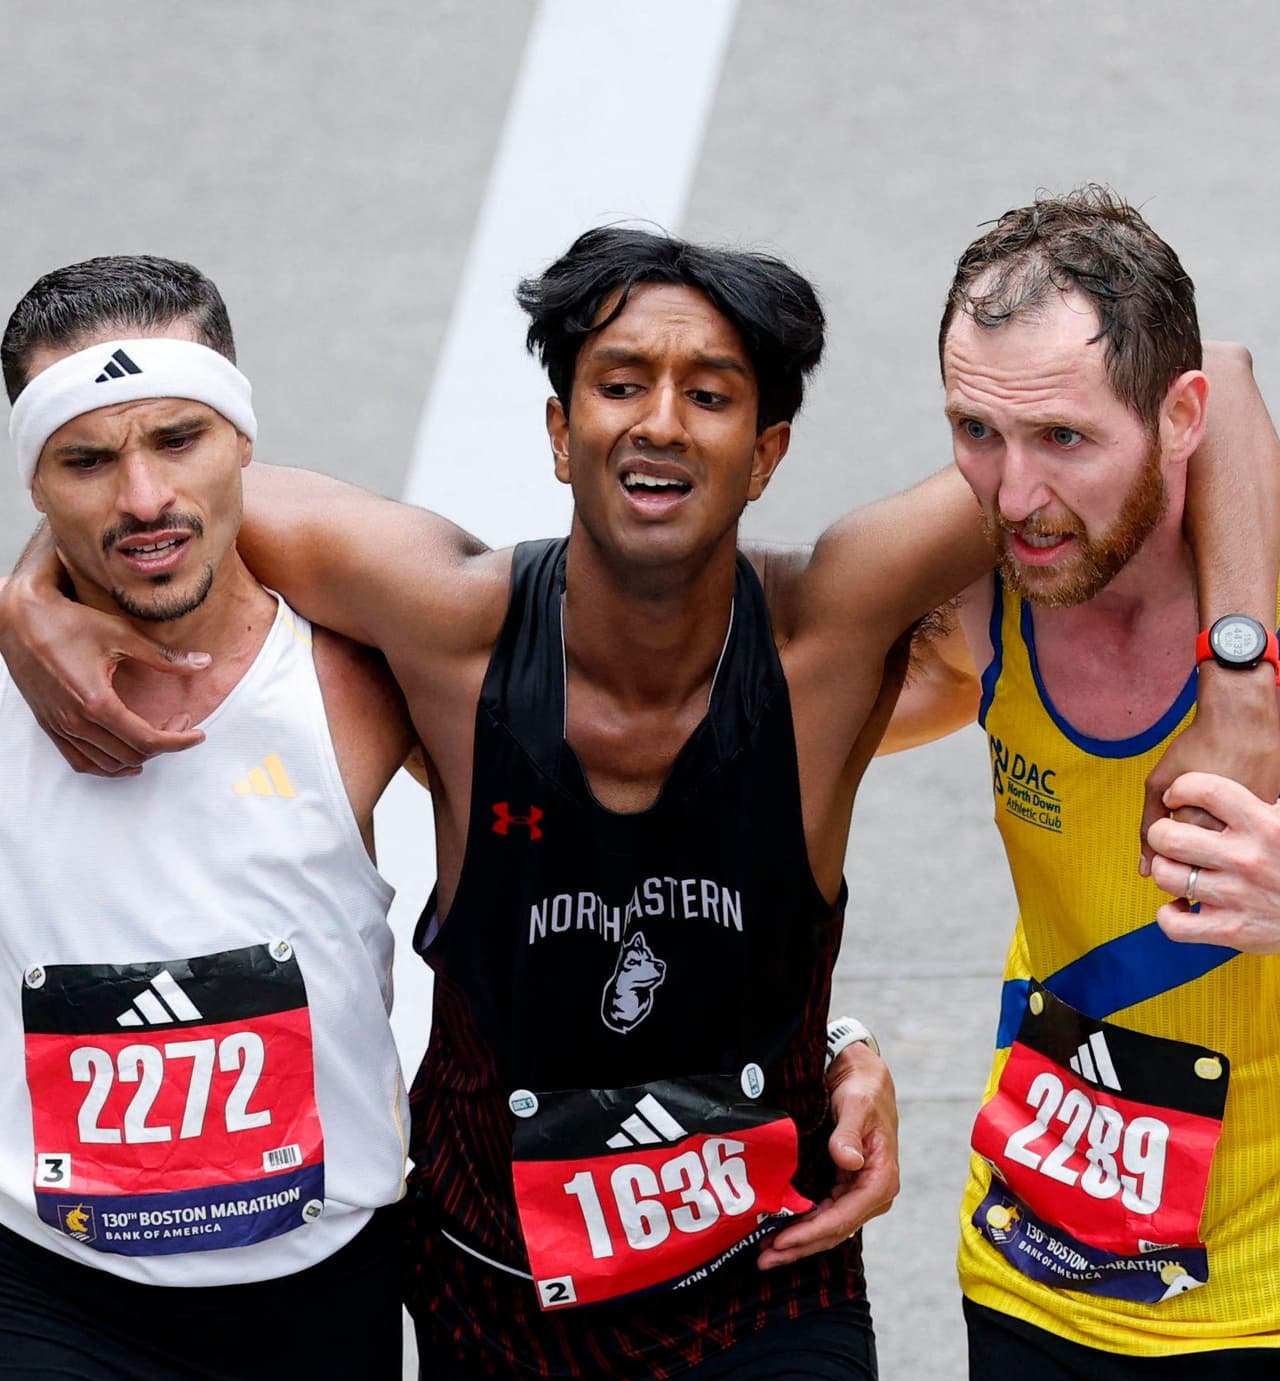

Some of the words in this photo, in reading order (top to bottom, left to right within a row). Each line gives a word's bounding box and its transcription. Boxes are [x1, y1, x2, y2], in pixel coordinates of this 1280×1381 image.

[1006, 797, 1037, 821] Athletic
[1039, 812, 1062, 828] Club
[1007, 780, 1030, 803] North
[1032, 795, 1061, 813] Down
[529, 876, 743, 945] NORHASTERN
[69, 1032, 271, 1145] 2272
[1003, 1072, 1169, 1215] 2289
[42, 1158, 63, 1183] 3
[101, 1212, 137, 1227] 130TH
[139, 1206, 207, 1226] BOSTON
[210, 1187, 301, 1219] MARATHON
[563, 1137, 756, 1260] 1636
[105, 1231, 141, 1241] BANK
[143, 1230, 160, 1239] OF
[163, 1223, 222, 1238] AMERICA
[1018, 1240, 1041, 1262] BANK
[1041, 1255, 1052, 1266] OF
[1051, 1263, 1102, 1281] AMERICA
[1046, 1237, 1089, 1271] BOSTON
[548, 1282, 570, 1302] 2
